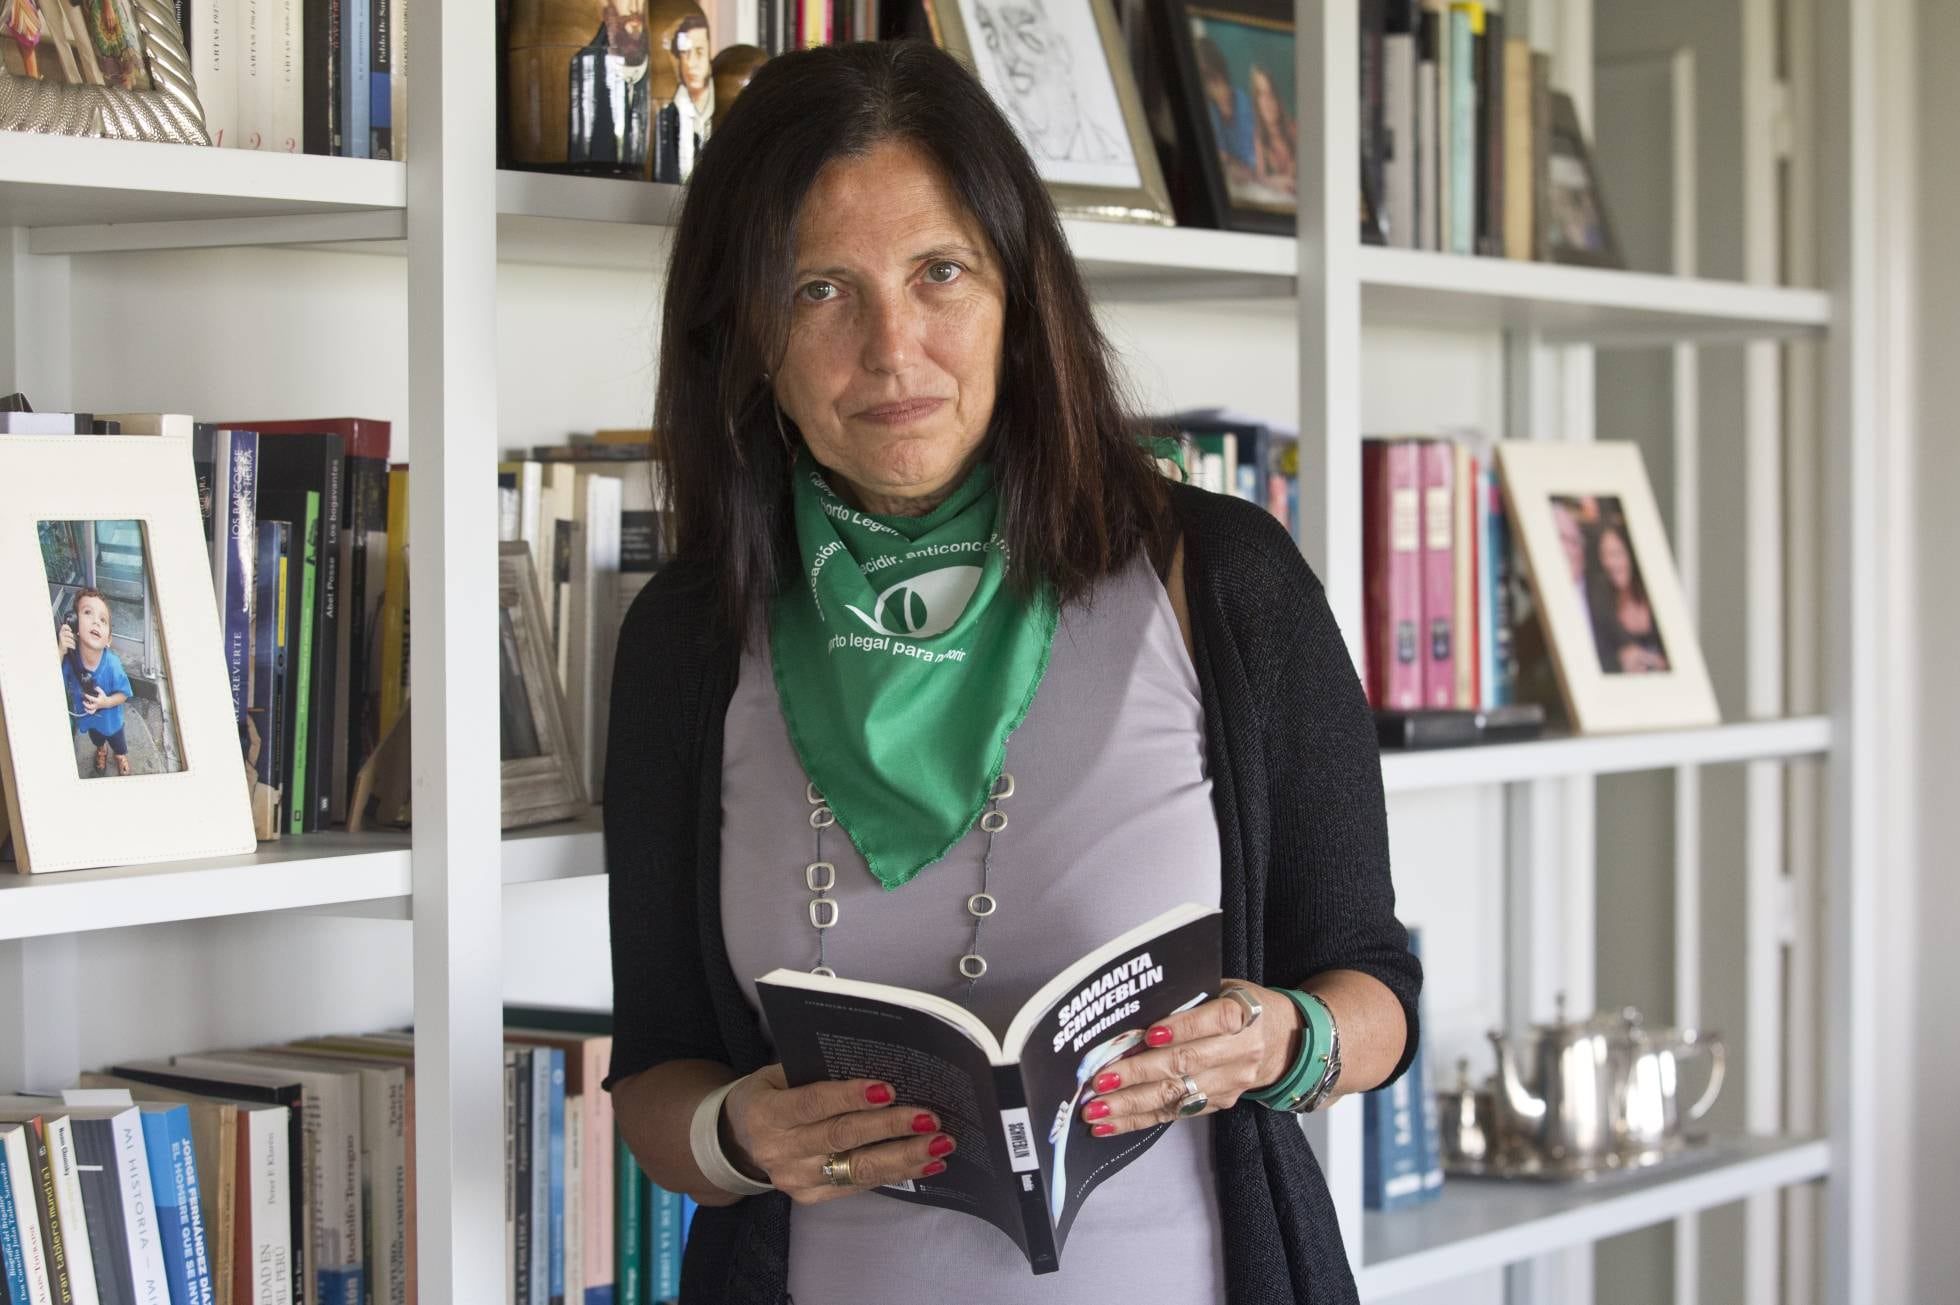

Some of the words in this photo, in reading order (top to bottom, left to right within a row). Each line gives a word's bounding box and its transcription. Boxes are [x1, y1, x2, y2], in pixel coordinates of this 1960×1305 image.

[329, 459, 340, 518] bogavantes
[328, 521, 337, 544] Los
[327, 557, 337, 590] Posse
[326, 592, 336, 618] Abel
[849, 633, 890, 652] legal
[892, 641, 934, 663] para
[1052, 965, 1164, 1053] SCHWEBLIN
[1058, 952, 1153, 1028] SAMANTA
[1072, 1000, 1141, 1052] Kentukis
[171, 1142, 181, 1161] EL
[181, 1137, 196, 1187] JORGE
[41, 1166, 58, 1217] mundial
[122, 1128, 134, 1151] MI
[128, 1158, 150, 1250] HISTORIA
[174, 1162, 190, 1226] HOMBRE
[51, 1221, 66, 1270] tablero
[181, 1225, 194, 1258] QUE
[188, 1186, 208, 1276] FERNÁNDEZ
[344, 1203, 357, 1265] Rodolfo
[58, 1272, 72, 1305] gran
[185, 1259, 197, 1280] SE
[201, 1274, 215, 1305] DÍA
